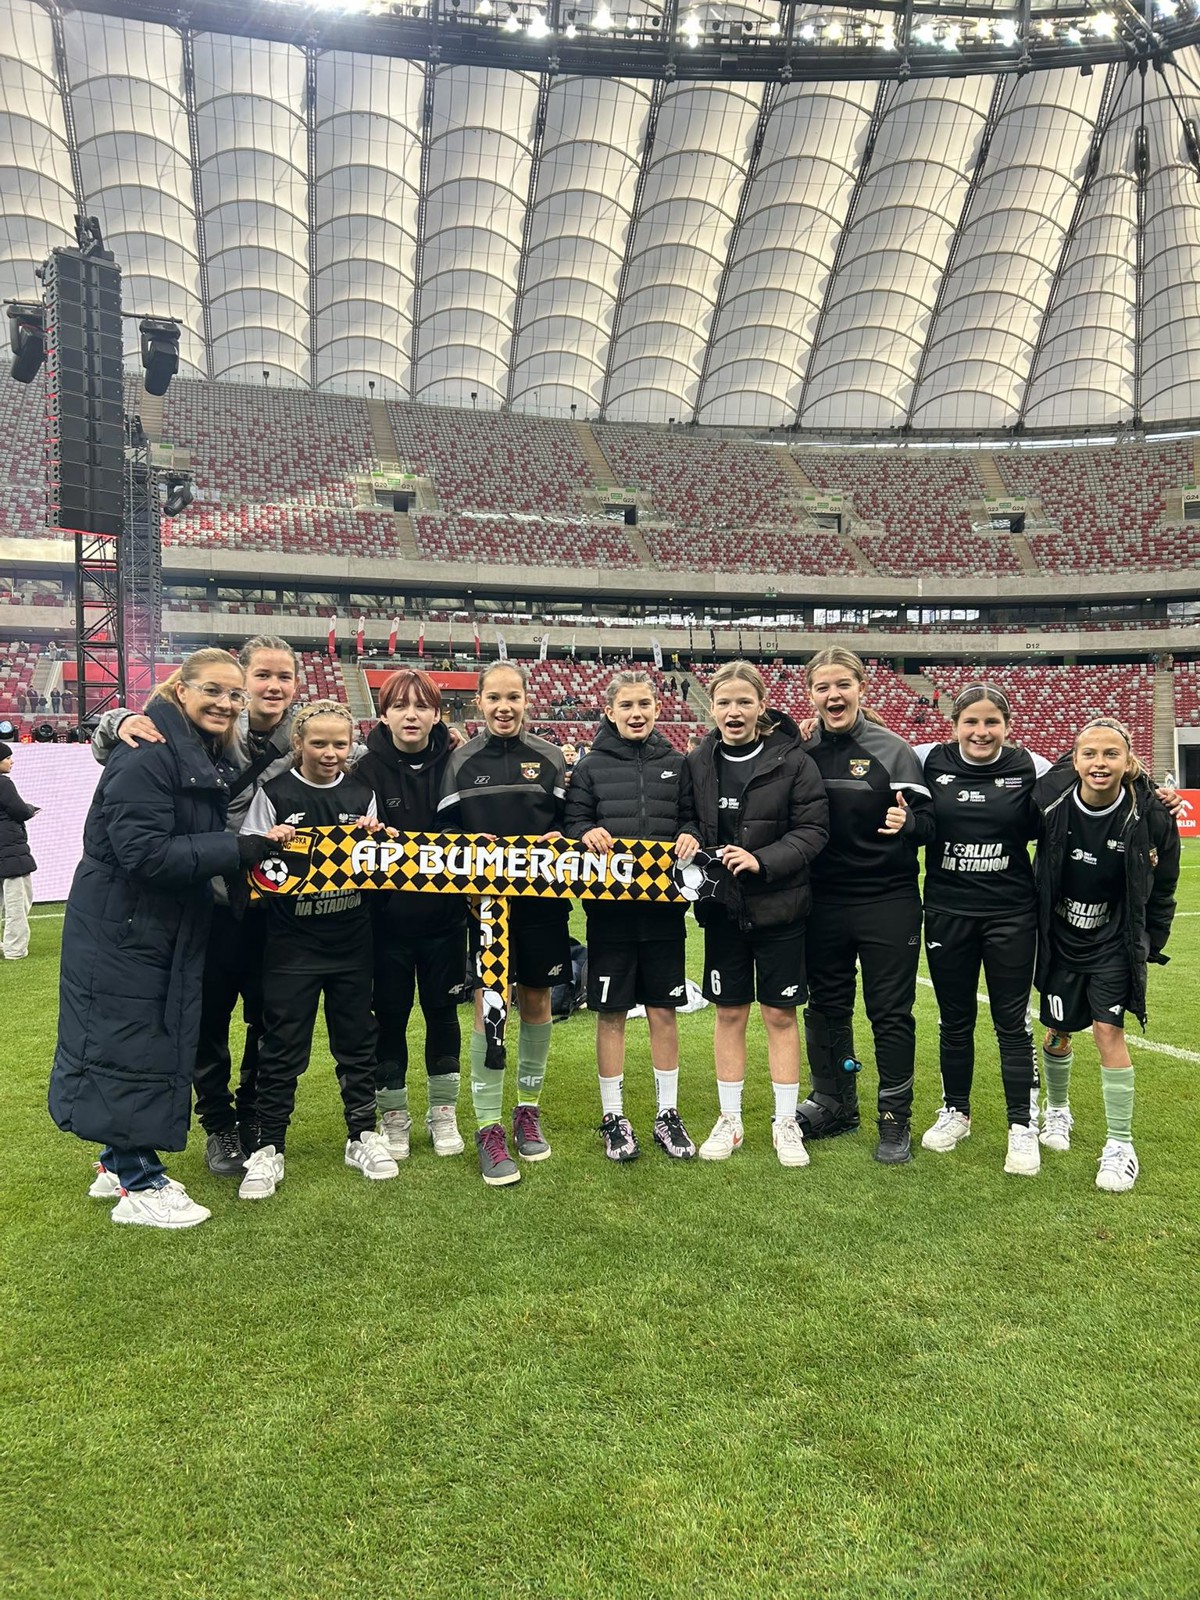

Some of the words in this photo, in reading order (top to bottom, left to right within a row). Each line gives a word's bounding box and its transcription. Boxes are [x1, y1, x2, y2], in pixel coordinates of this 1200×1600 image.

[935, 773, 957, 786] 4F
[284, 812, 306, 825] 4F
[1177, 819, 1196, 828] RLEN
[351, 839, 405, 875] AP
[418, 844, 634, 884] BUMERANG
[941, 855, 956, 871] NA
[958, 855, 1010, 872] STADION
[295, 901, 312, 916] NA
[315, 891, 362, 915] STADION
[548, 963, 563, 976] 4F
[448, 983, 465, 995] 4F
[710, 969, 722, 996] 6
[598, 976, 611, 1003] 7
[669, 985, 685, 997] 4F
[781, 984, 799, 997] 4F
[1047, 993, 1064, 1022] 10
[519, 1075, 544, 1087] 4F
